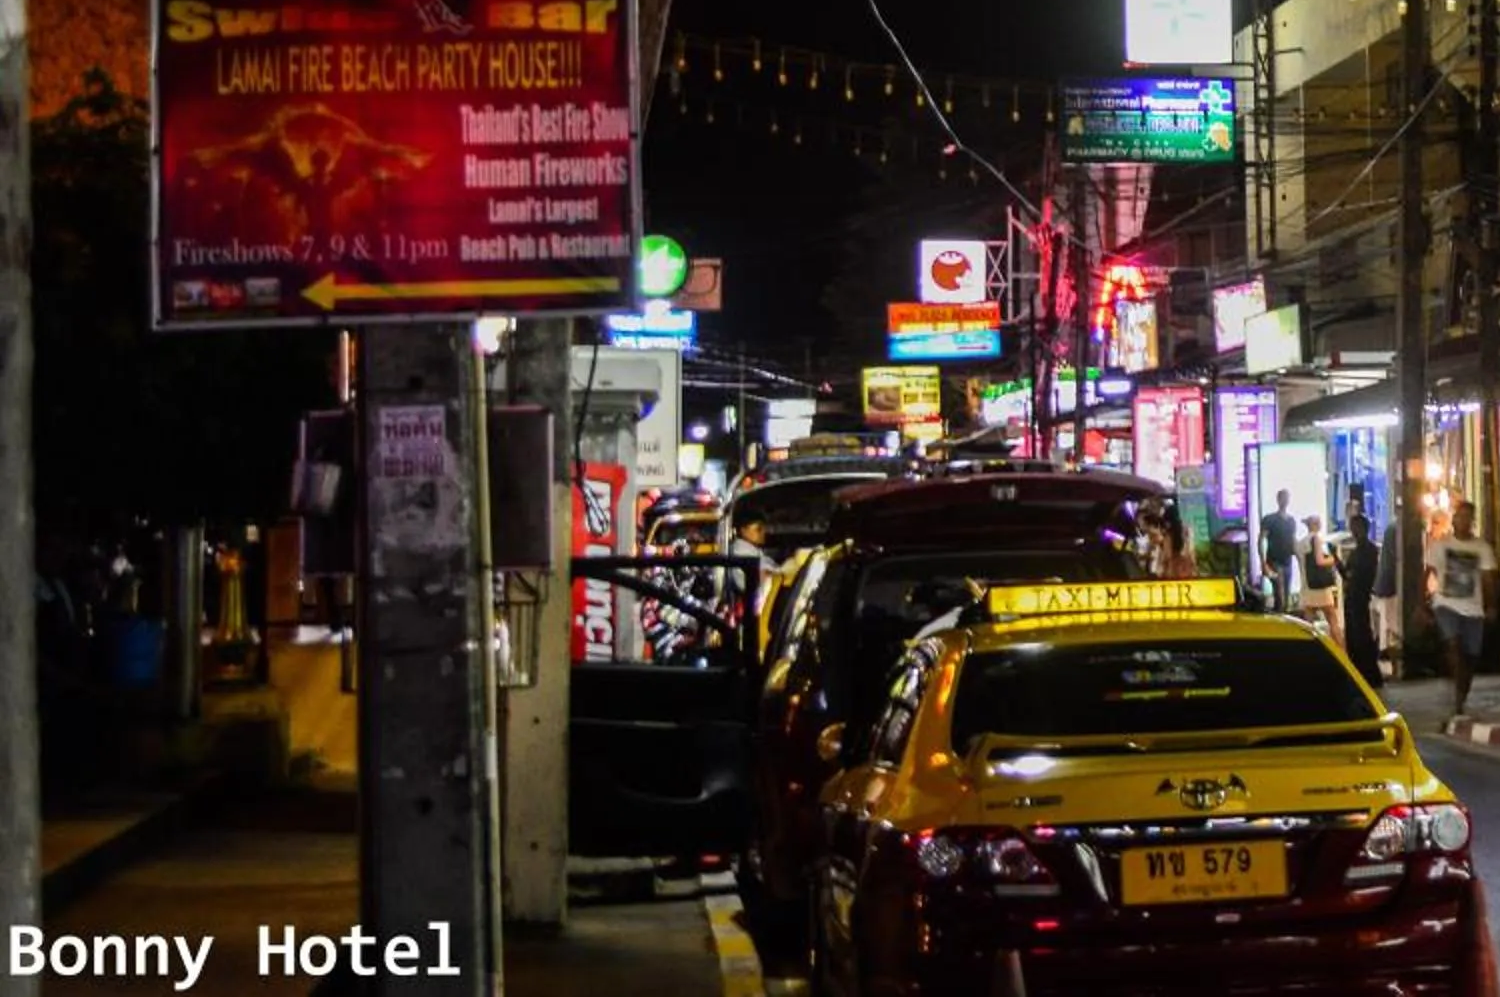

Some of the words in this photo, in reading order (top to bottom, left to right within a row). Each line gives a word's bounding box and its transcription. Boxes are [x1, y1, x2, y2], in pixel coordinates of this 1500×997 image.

[216, 44, 282, 95] LAMAI
[288, 44, 334, 93] FIRE
[341, 43, 409, 92] BEACH
[416, 42, 483, 91] PARTY
[488, 40, 583, 90] HOUSE!!!
[460, 103, 531, 145] Thailand's
[531, 103, 563, 143] Best
[565, 102, 591, 142] Fire
[592, 101, 629, 141] Show
[464, 153, 532, 189] Human
[534, 151, 628, 187] Fireworks
[545, 195, 599, 225] Largest
[174, 239, 294, 265] Fireshows
[330, 234, 346, 261] 9
[352, 234, 373, 260] &
[382, 234, 450, 265] 11pm
[508, 234, 536, 261] Pub
[1203, 847, 1251, 875] 579
